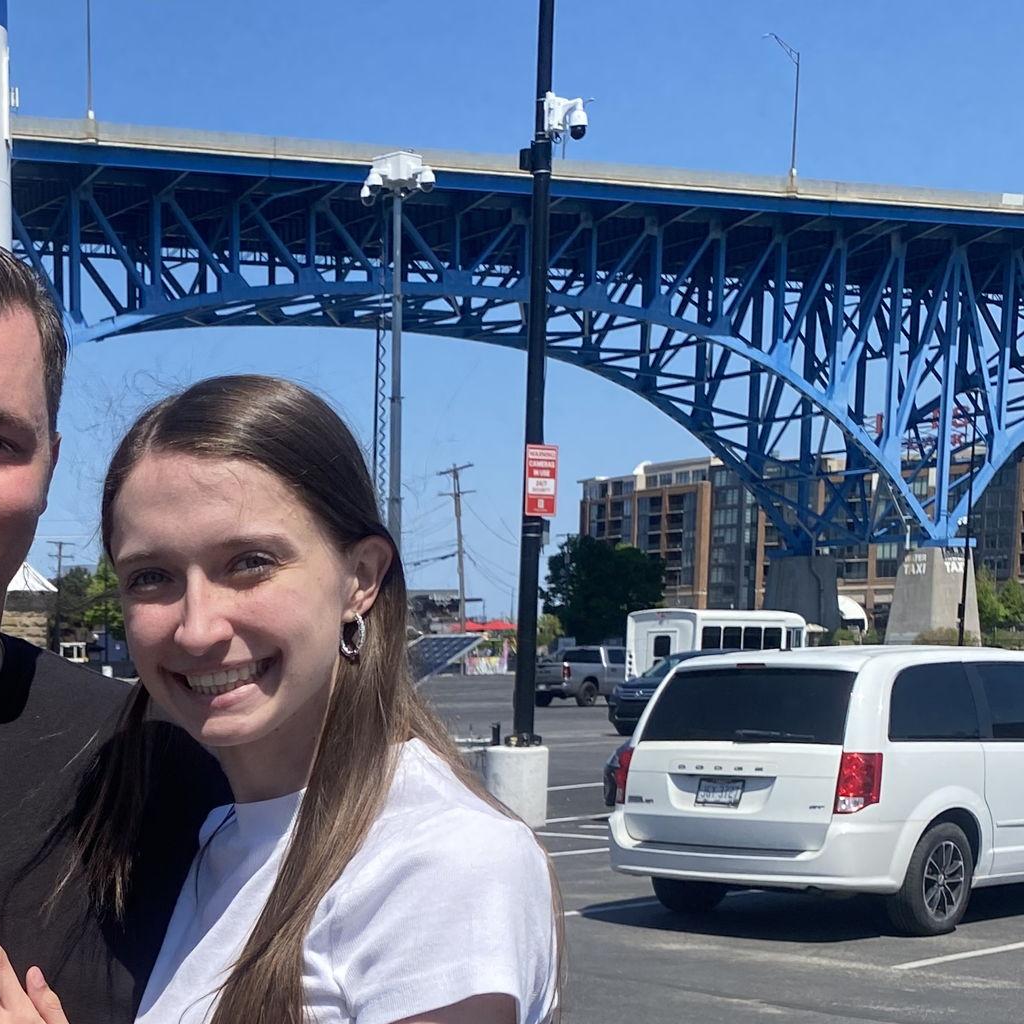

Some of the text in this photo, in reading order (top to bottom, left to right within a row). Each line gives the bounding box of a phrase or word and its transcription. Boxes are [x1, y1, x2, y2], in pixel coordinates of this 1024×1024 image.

[903, 563, 927, 576] TAXI
[944, 561, 965, 574] TAX
[678, 764, 763, 772] DODGE
